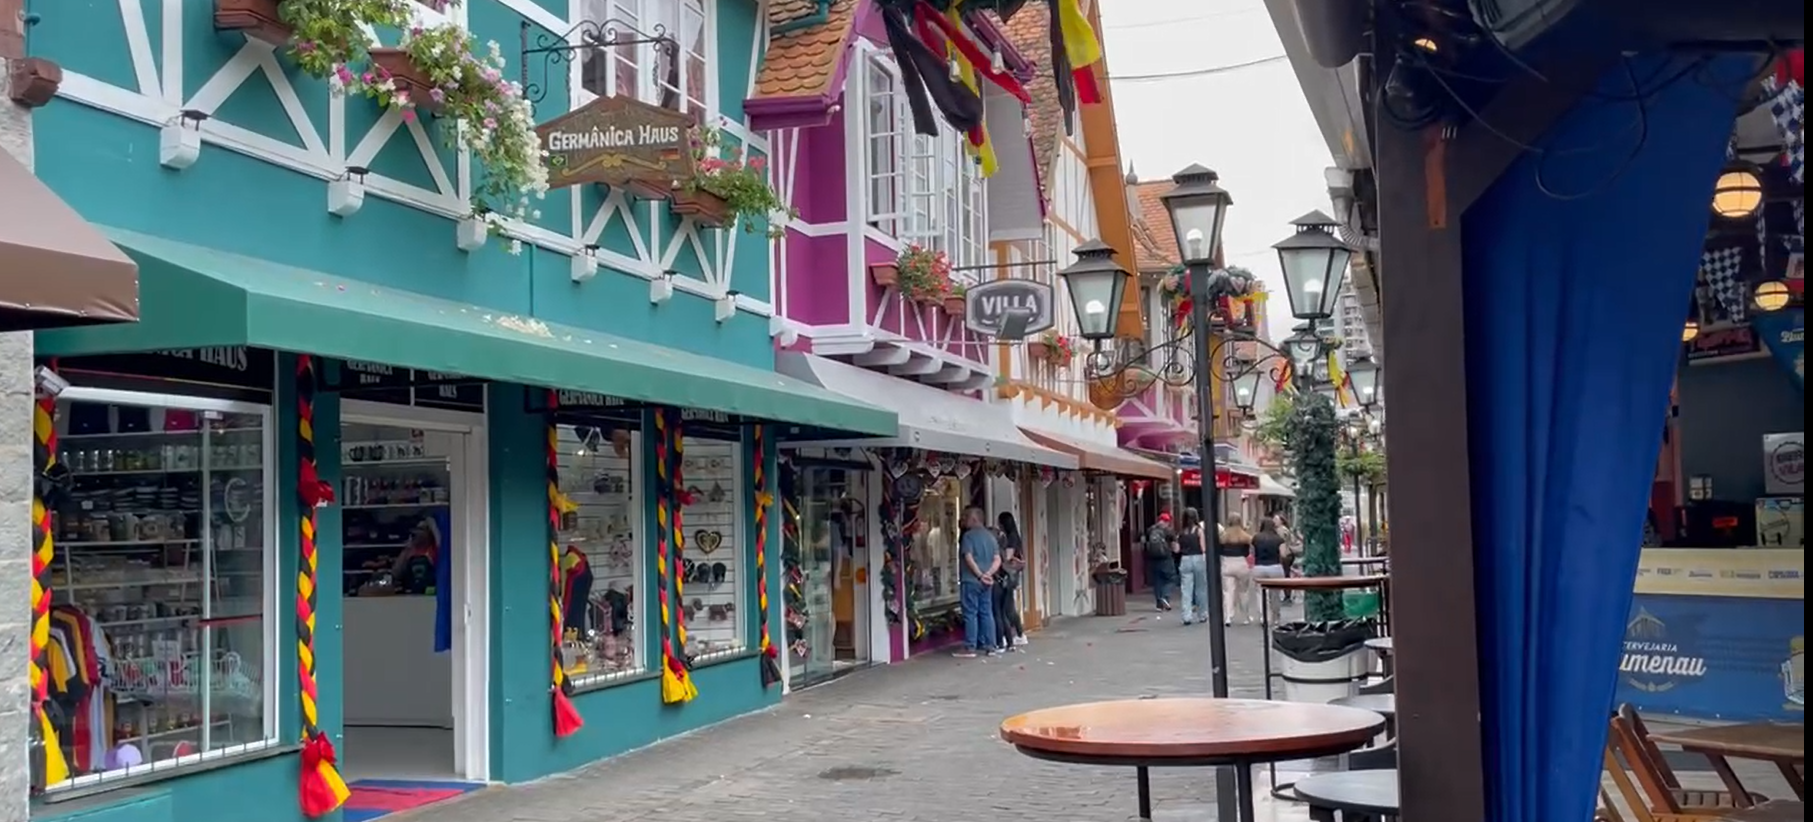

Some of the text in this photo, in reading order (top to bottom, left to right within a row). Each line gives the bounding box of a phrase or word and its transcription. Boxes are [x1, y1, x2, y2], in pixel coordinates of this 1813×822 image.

[549, 124, 679, 150] GERMÂNICA HAUS
[981, 293, 1038, 316] VILLA
